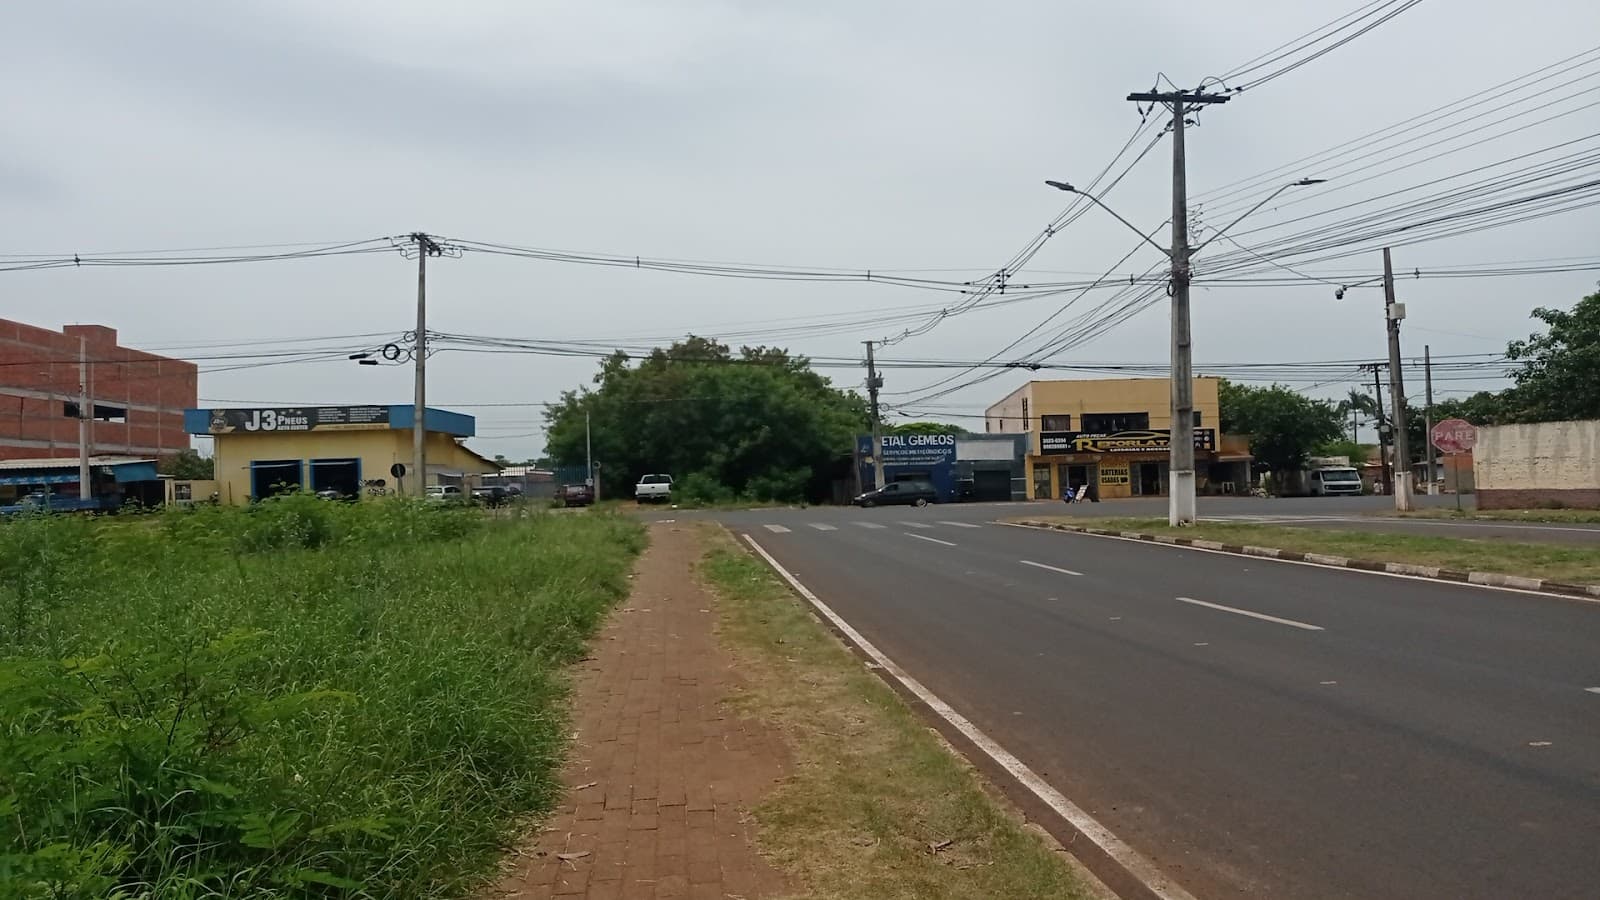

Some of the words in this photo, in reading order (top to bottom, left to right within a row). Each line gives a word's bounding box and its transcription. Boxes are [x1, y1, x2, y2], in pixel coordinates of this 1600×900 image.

[245, 410, 277, 431] J3
[881, 436, 906, 447] ETAL
[1435, 431, 1473, 441] PARE
